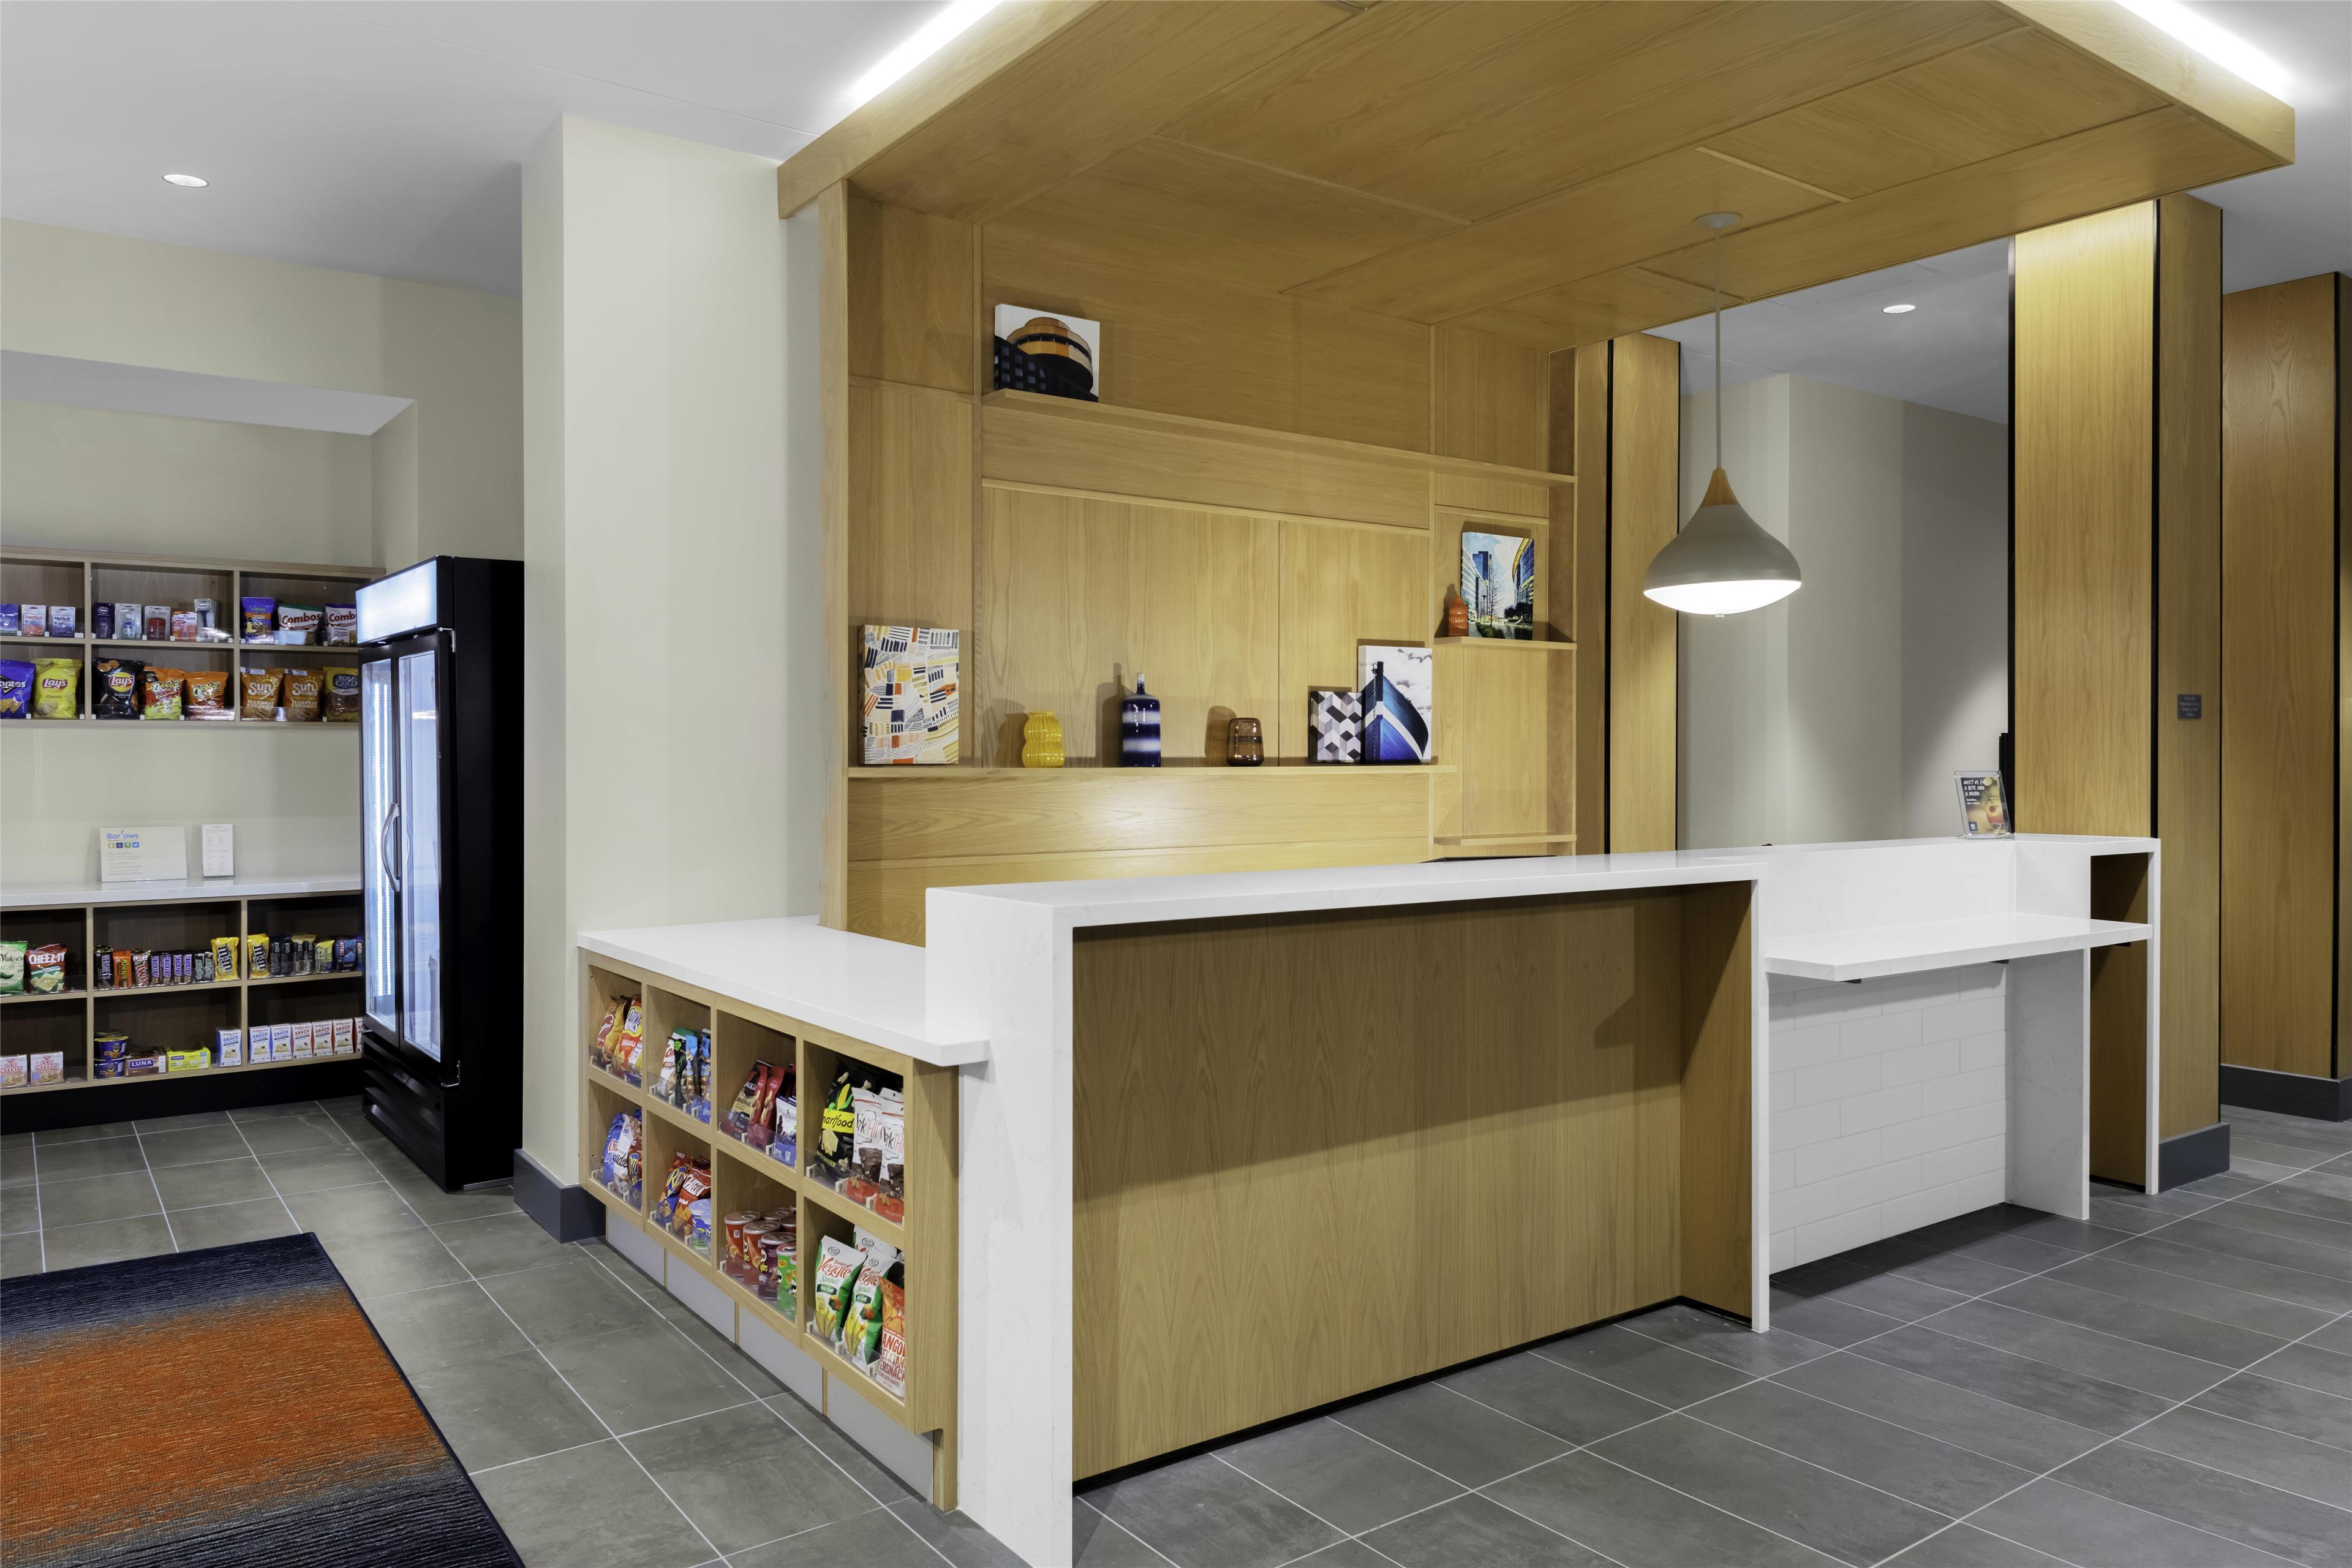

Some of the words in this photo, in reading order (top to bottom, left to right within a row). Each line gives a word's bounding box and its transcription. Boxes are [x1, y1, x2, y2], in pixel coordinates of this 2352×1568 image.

[281, 613, 322, 625] Combos
[43, 679, 67, 689] Lay's
[111, 676, 133, 687] Lay's
[153, 680, 181, 693] Cheetos
[817, 1254, 851, 1278] Veggie
[882, 1333, 905, 1357] ANGO
